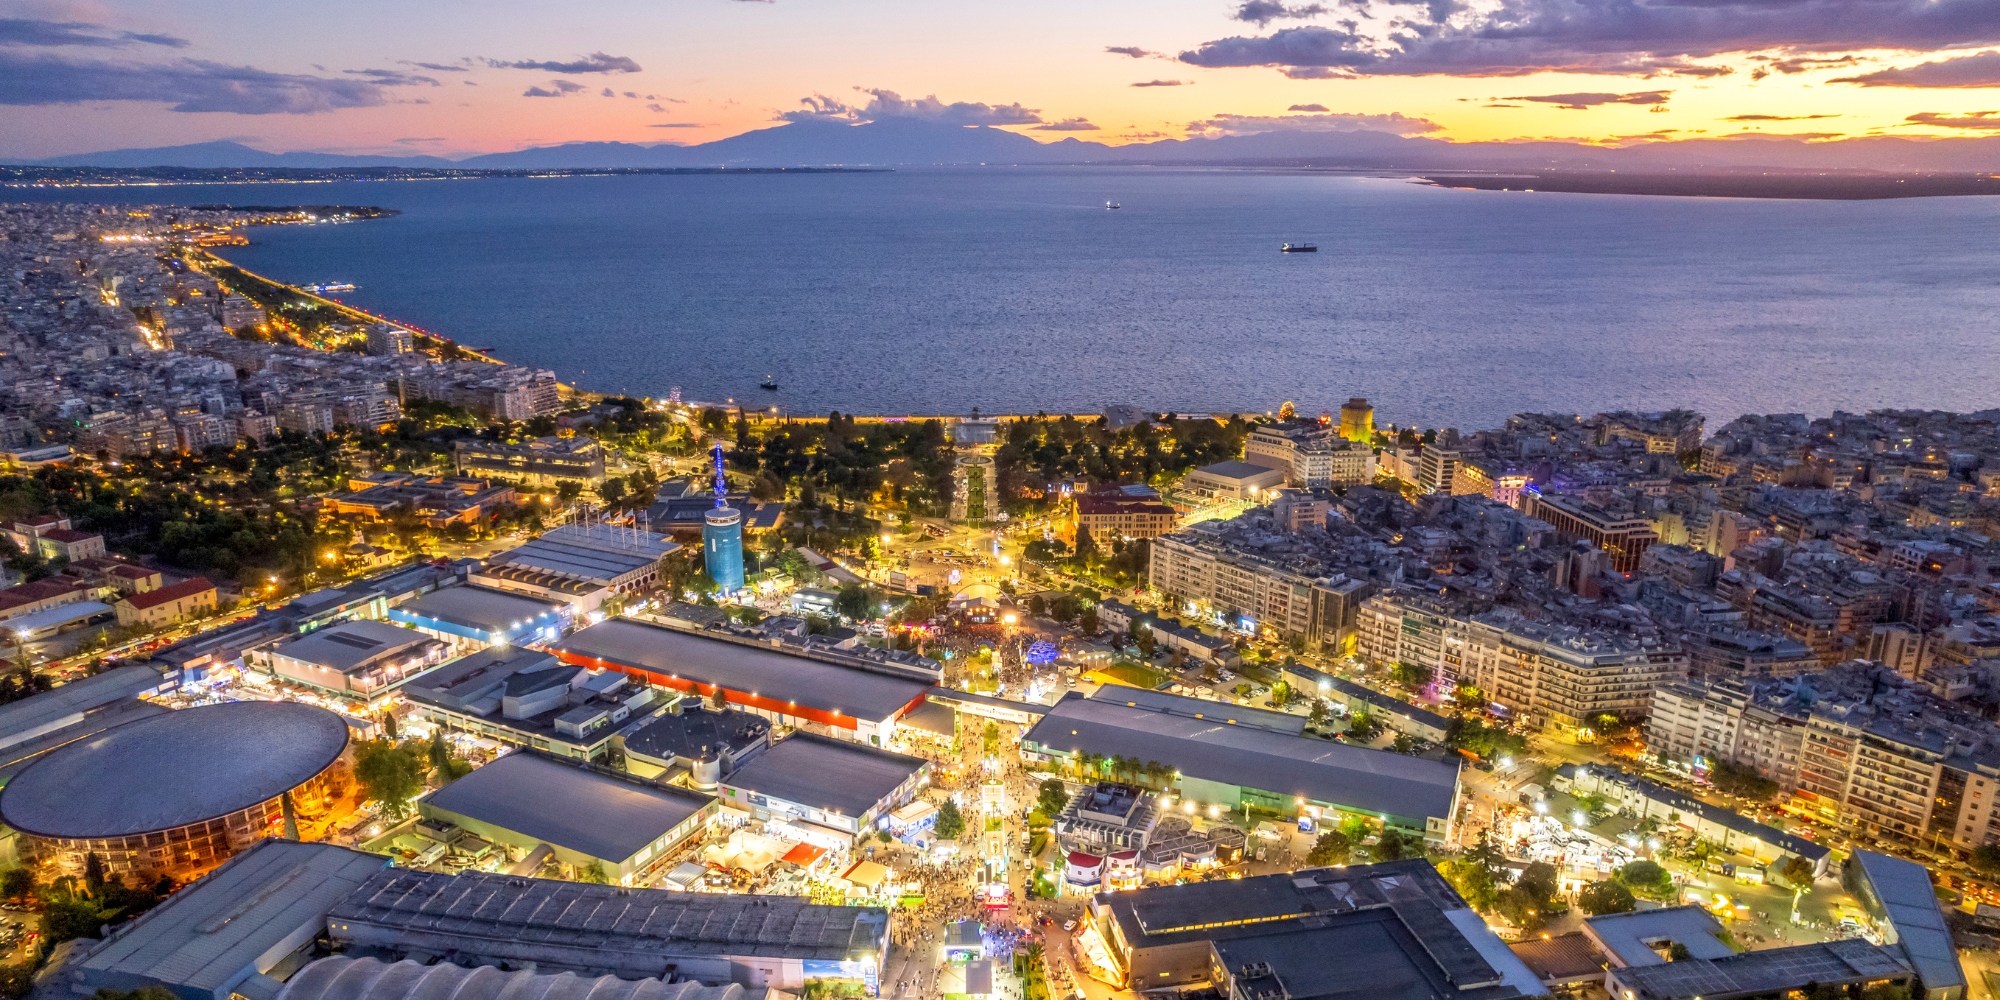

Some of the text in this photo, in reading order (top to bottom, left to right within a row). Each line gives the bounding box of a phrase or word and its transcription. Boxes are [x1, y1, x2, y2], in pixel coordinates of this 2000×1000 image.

[560, 609, 571, 618] 12
[1024, 741, 1033, 750] 15
[706, 805, 714, 817] 16
